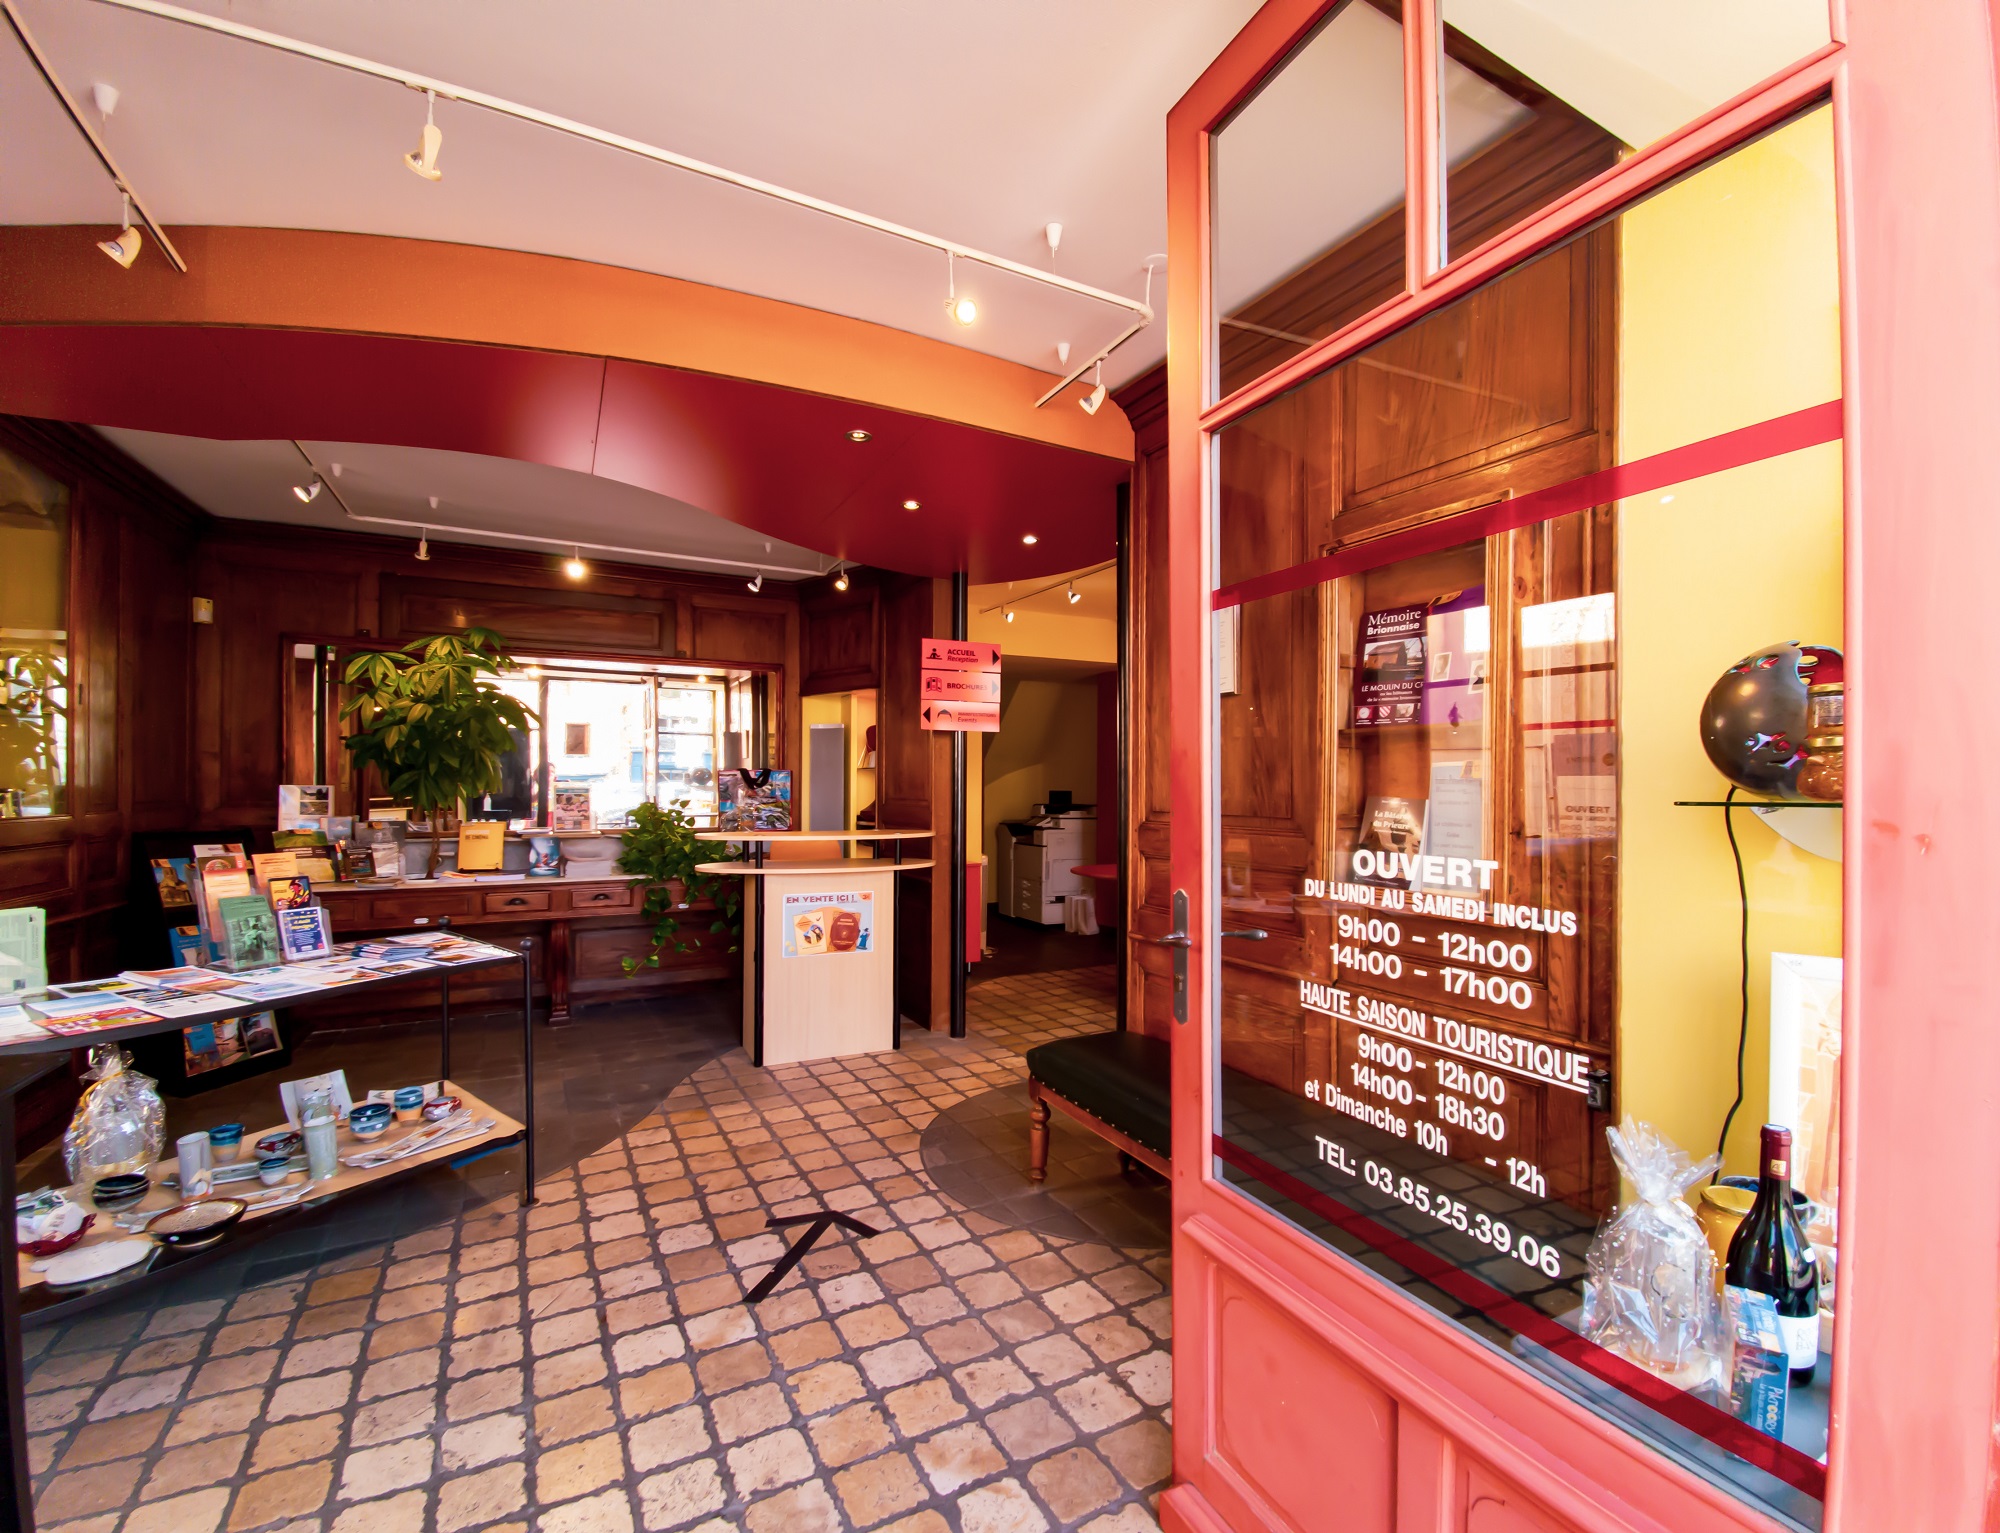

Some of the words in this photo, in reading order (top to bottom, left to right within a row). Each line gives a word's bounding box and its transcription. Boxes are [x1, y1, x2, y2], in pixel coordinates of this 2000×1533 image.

[1367, 622, 1420, 636] Brionnaise
[1368, 610, 1421, 626] Mémoire
[947, 655, 979, 663] Reception
[947, 682, 988, 690] BROCHURES
[1369, 683, 1400, 692] MOULIN
[1353, 849, 1499, 890] OUVERT
[786, 896, 799, 904] EN
[802, 895, 834, 903] VENTE
[836, 894, 849, 902] ICI
[1304, 878, 1325, 898] DU
[1330, 881, 1375, 906] LUNDI
[1381, 888, 1405, 910] AU
[1412, 892, 1485, 923] SAMEDI
[1493, 903, 1577, 937] INCLUS
[1338, 914, 1401, 947] 9h00
[1412, 934, 1426, 944] -
[1438, 931, 1532, 973] 12h00
[1330, 943, 1402, 979] 14h00
[1414, 967, 1428, 977] -
[1440, 967, 1532, 1010] 17h00
[1300, 979, 1351, 1016] HAUTE
[1357, 995, 1426, 1039] SAISON
[1433, 1016, 1590, 1086] TOURISTIQUE
[1435, 1059, 1505, 1105] 12h00
[1304, 1079, 1320, 1101] et
[1325, 1083, 1407, 1138] Dimanche
[1414, 1120, 1448, 1156] 10h
[1484, 1156, 1497, 1167] -
[1506, 1157, 1546, 1198] 12h
[1435, 1093, 1505, 1141] 18h30
[1364, 1160, 1561, 1278] 03.85.25.39.06
